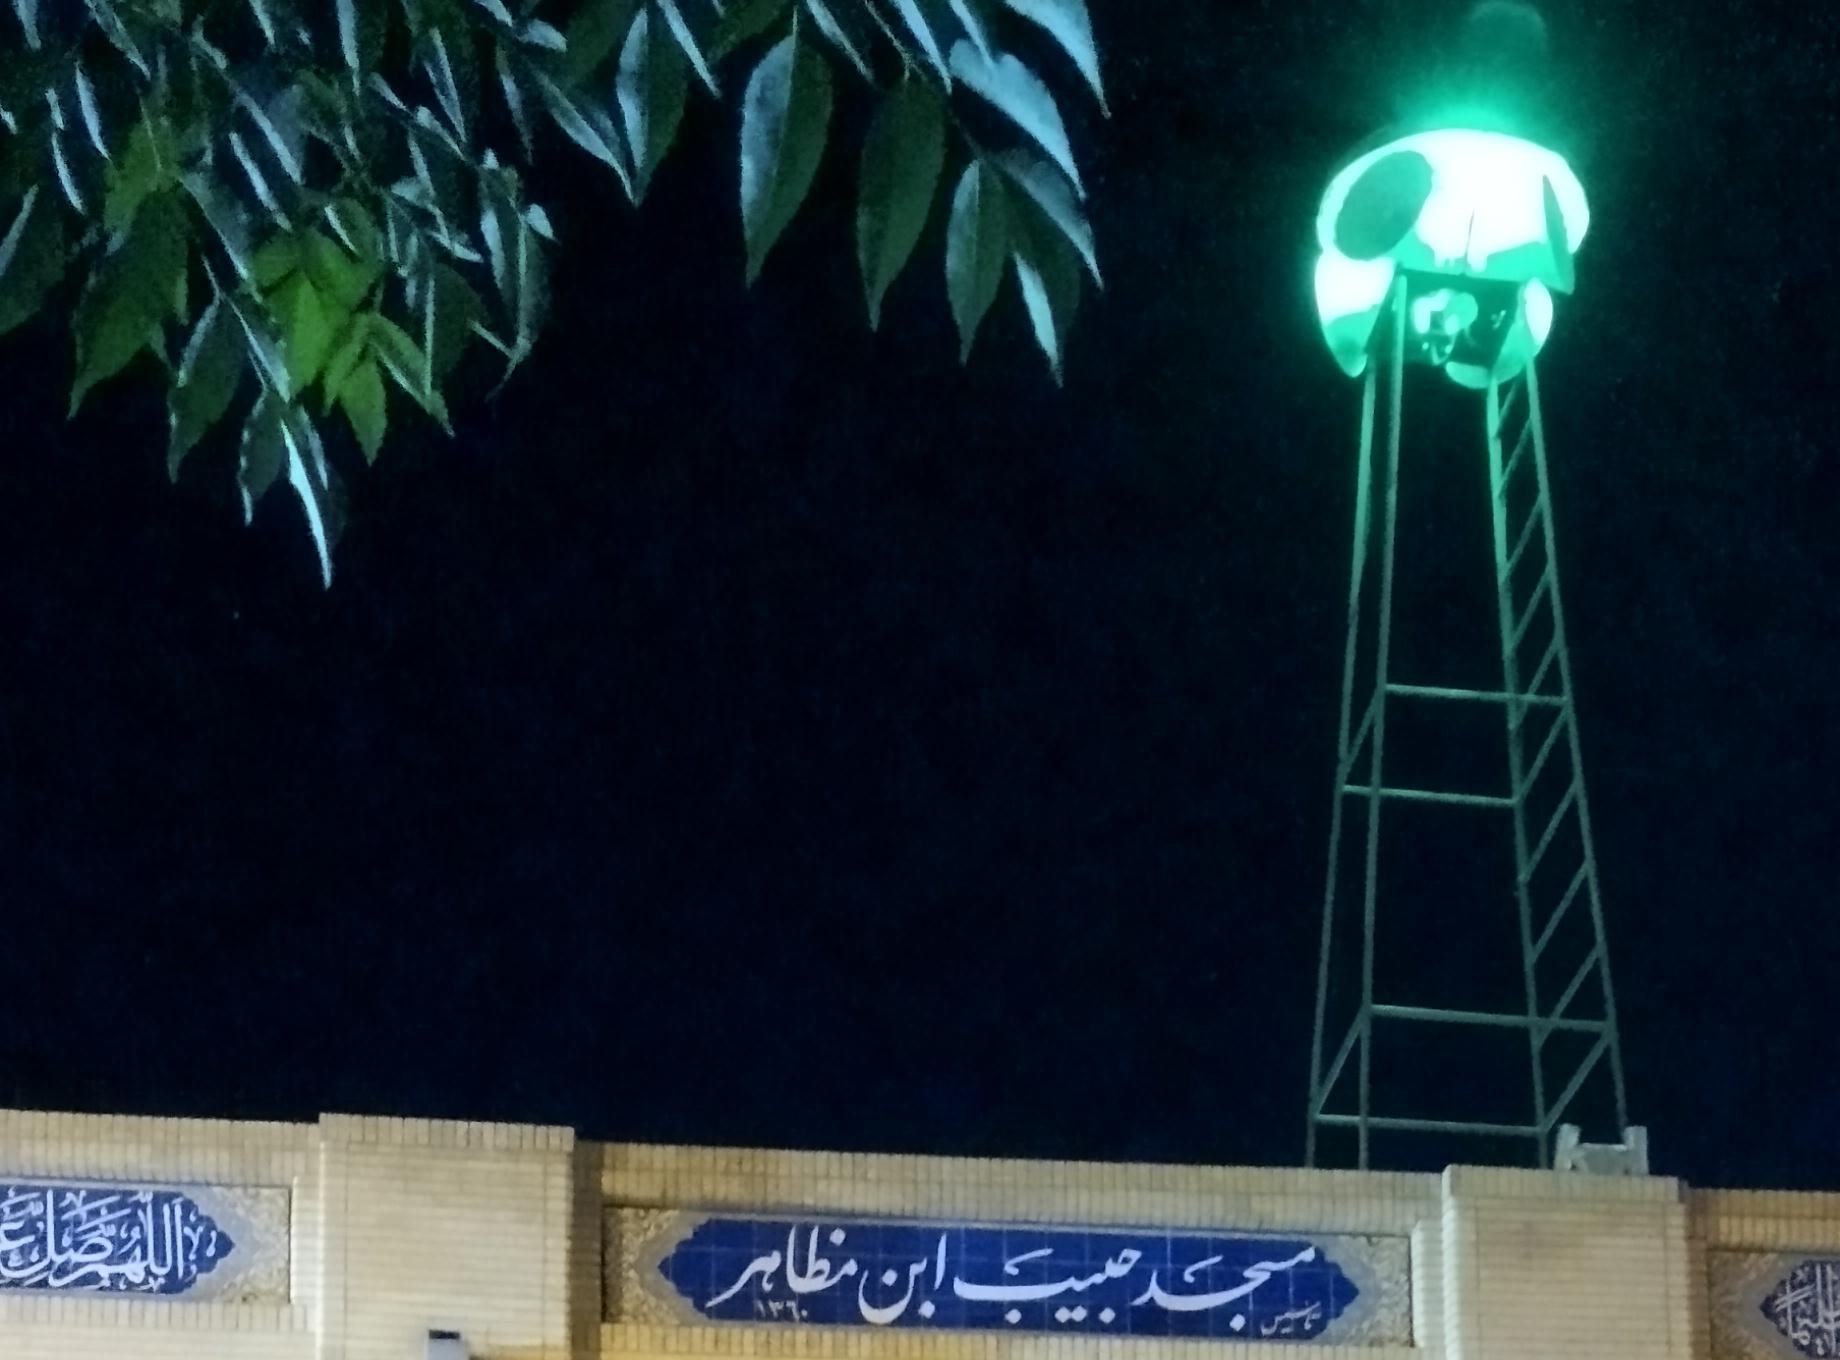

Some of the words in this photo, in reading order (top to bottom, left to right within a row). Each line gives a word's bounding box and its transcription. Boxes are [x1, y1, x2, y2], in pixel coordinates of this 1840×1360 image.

[706, 1225, 858, 1307] مظاهر
[858, 1234, 947, 1326] ابن
[953, 1248, 1142, 1324] حبیب
[1133, 1245, 1316, 1331] مسجد
